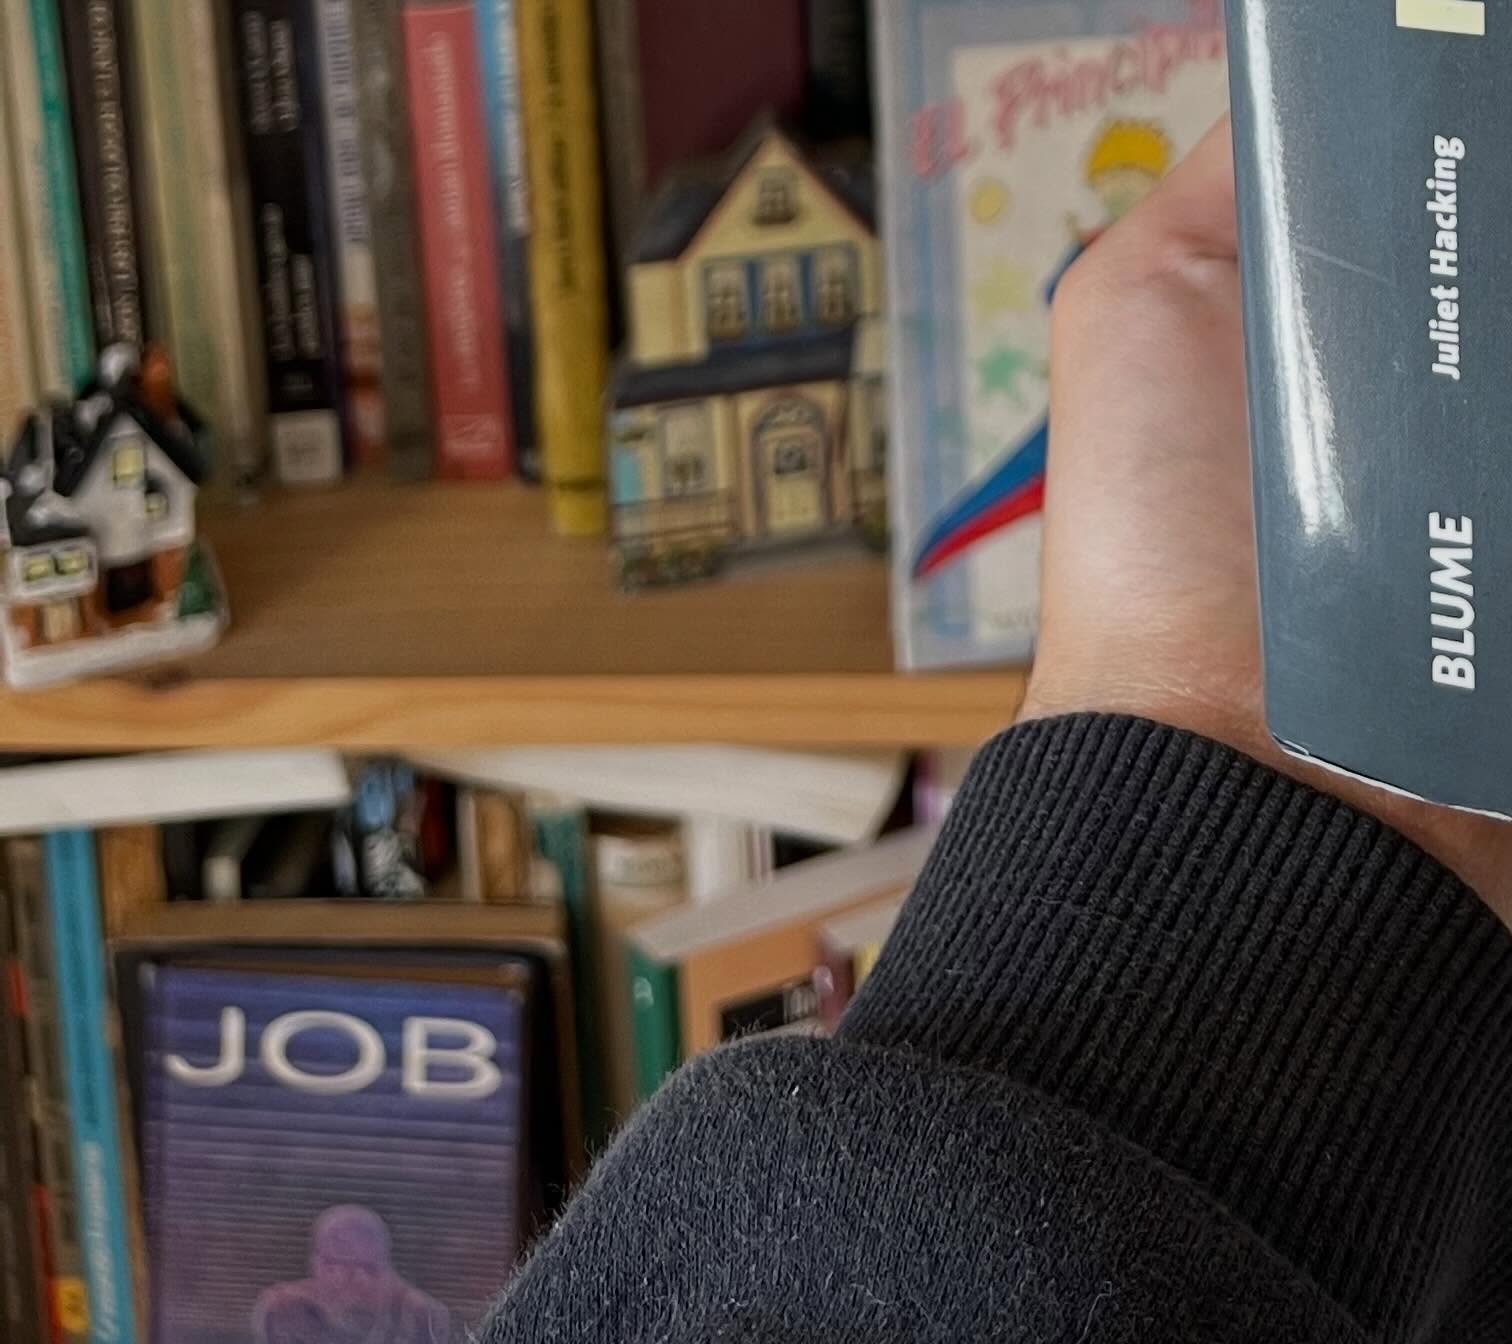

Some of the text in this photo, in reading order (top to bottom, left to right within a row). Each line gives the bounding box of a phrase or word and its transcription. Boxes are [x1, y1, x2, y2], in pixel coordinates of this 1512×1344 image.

[1425, 135, 1466, 382] Juliet Hacking
[1428, 511, 1476, 690] BLUME
[164, 1005, 502, 1101] JOB
